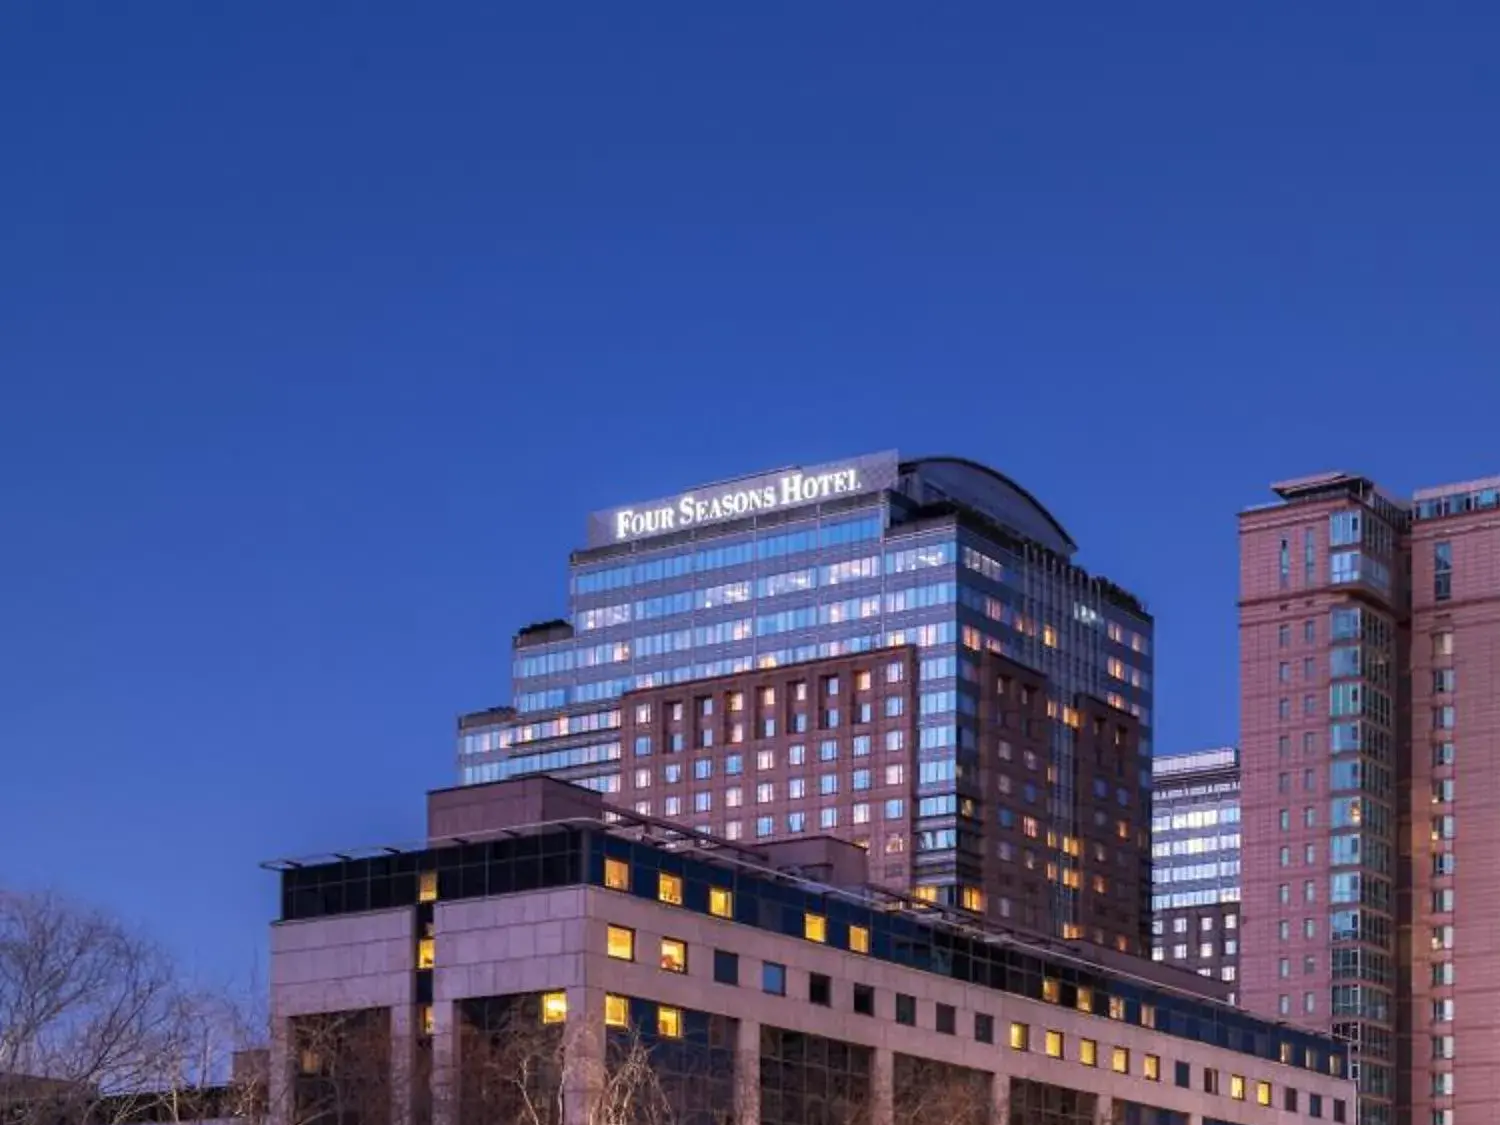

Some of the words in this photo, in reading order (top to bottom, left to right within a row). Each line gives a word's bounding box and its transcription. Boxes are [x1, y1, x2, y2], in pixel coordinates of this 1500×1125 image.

[616, 508, 675, 538] FOUR
[679, 486, 775, 525] SEASONS
[780, 469, 862, 505] HOTEL
